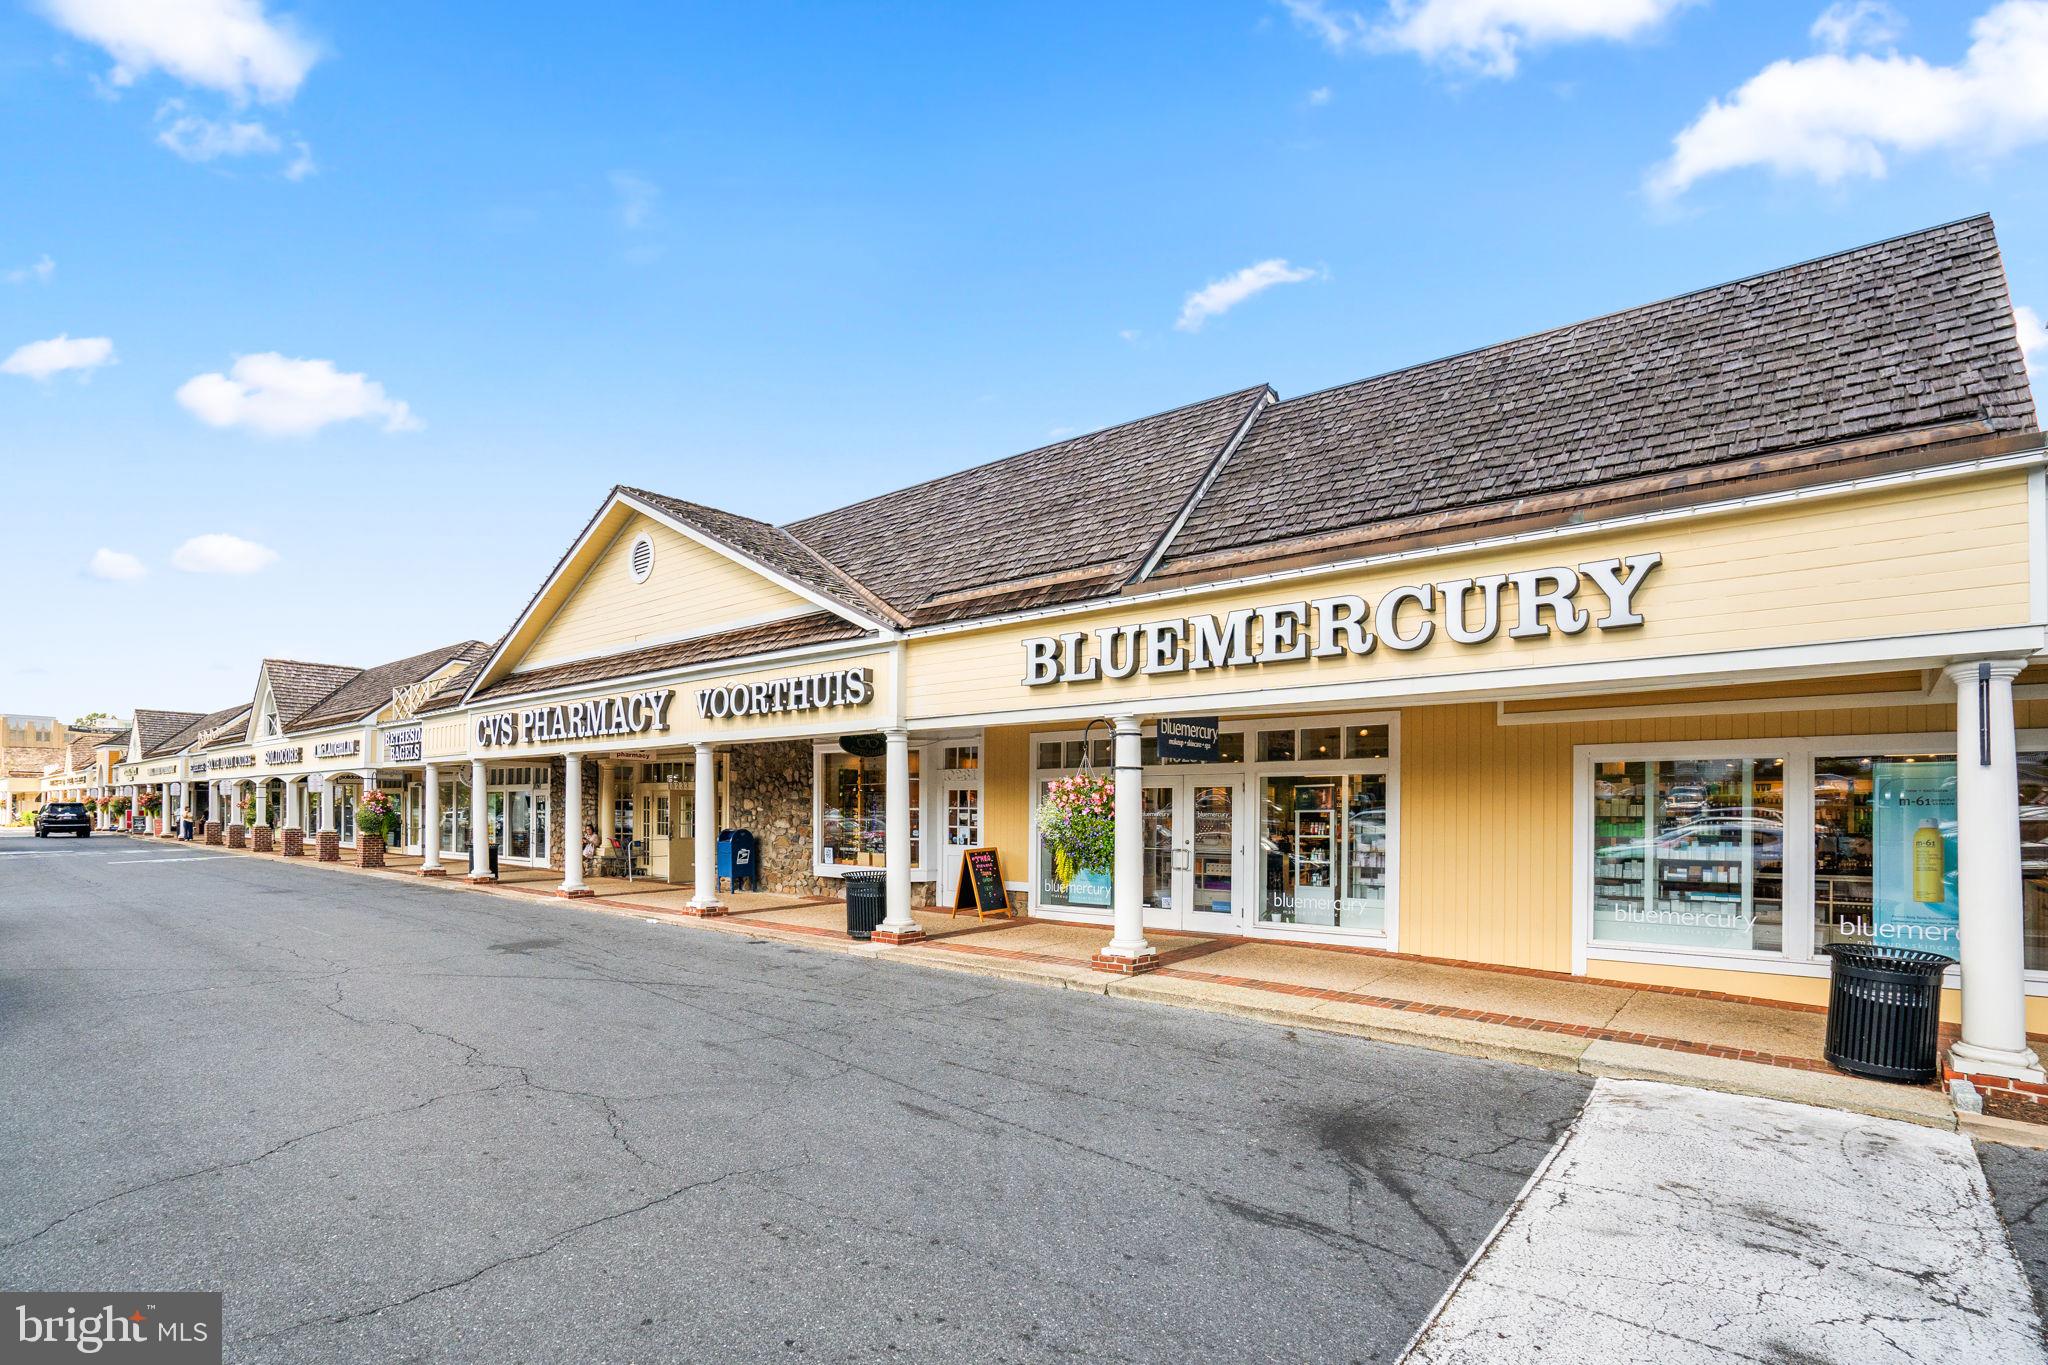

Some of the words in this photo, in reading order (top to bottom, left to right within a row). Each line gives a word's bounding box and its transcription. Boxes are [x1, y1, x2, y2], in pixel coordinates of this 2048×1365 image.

[1020, 551, 1662, 688] BLUEMERCURY
[694, 667, 871, 719] VOORTHUIS
[475, 712, 516, 747] CVS
[519, 689, 673, 743] PHARMACY
[1161, 717, 1218, 744] bluemercury
[390, 744, 420, 761] BAGELS
[616, 751, 650, 760] pharmacy
[1899, 796, 1931, 806] m-61
[1197, 810, 1229, 819] bluemercury
[1915, 840, 1935, 848] m-61
[1044, 879, 1112, 899] bluemercury
[1273, 891, 1367, 914] bluemercury
[1615, 903, 1758, 934] bluemercury
[1912, 943, 1960, 952] skincar
